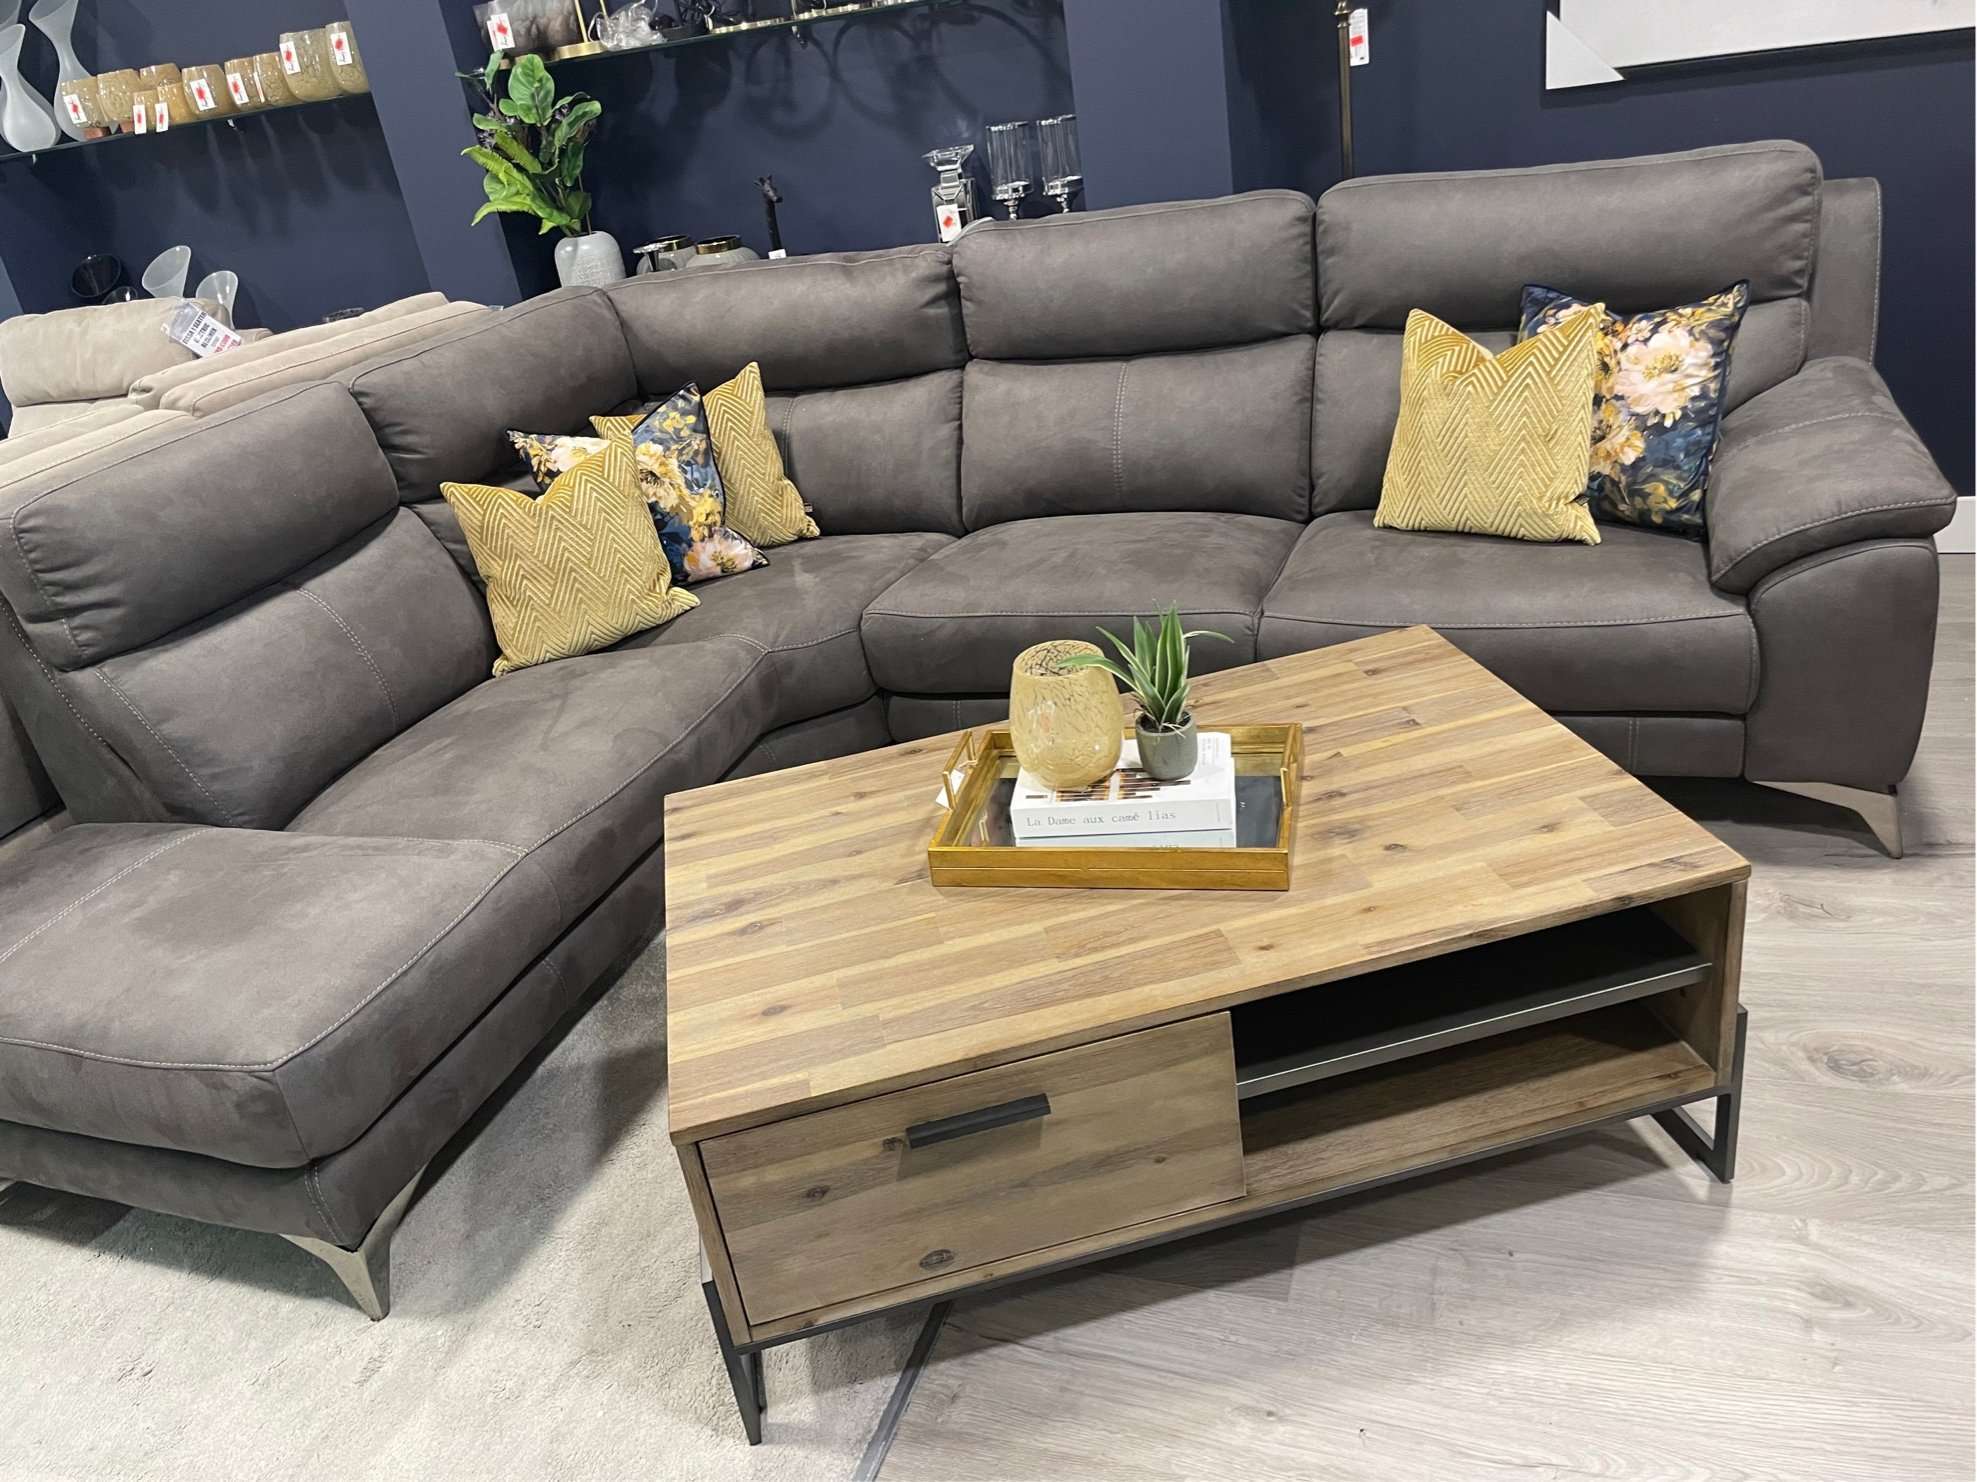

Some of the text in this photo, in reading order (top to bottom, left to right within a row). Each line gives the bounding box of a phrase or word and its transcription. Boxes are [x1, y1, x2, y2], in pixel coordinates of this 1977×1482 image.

[1026, 810, 1176, 827] La Dame aux camé lias
